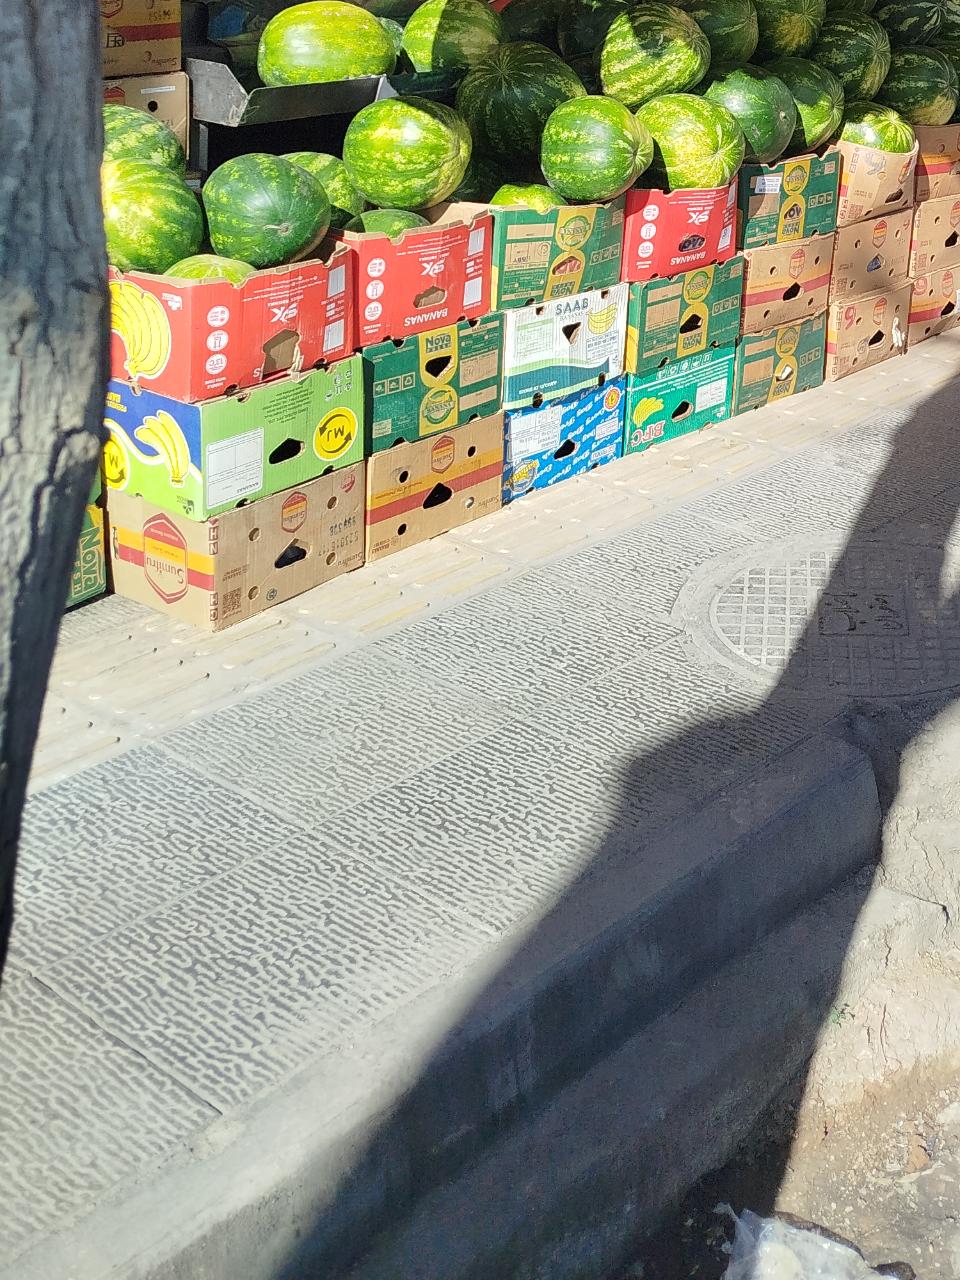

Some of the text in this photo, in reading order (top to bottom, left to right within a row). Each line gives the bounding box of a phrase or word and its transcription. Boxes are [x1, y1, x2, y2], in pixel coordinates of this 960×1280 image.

[670, 251, 706, 265] BANANAS
[555, 298, 588, 315] SAAB
[404, 308, 448, 326] BANANAS
[425, 334, 452, 349] Nova
[326, 425, 345, 442] MJ
[631, 420, 665, 446] BFC
[80, 527, 101, 593] Nova
